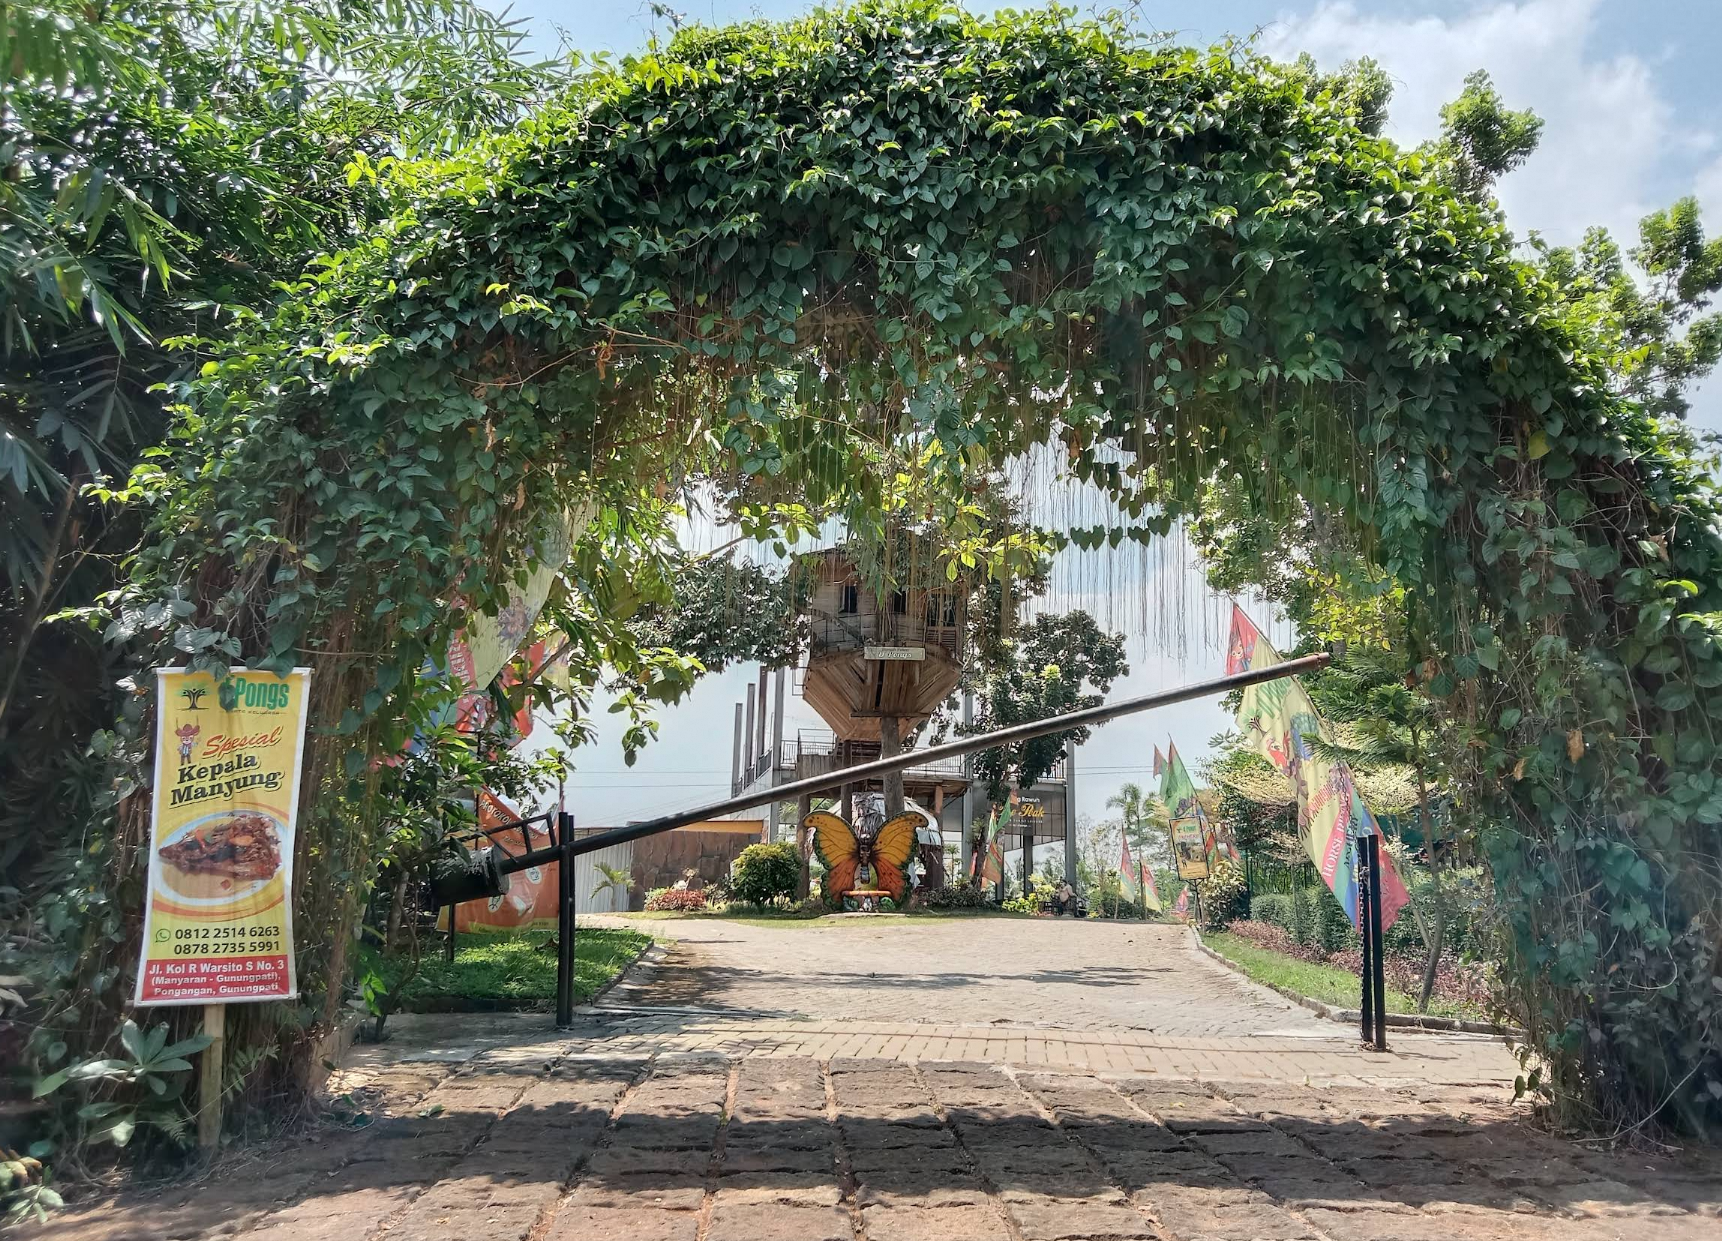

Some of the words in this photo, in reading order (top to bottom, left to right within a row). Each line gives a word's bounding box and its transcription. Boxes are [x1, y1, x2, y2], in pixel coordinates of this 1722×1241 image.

[202, 725, 282, 759] Spesial
[177, 753, 258, 785] Kepala
[170, 771, 281, 806] Manyung
[1320, 836, 1343, 878] HORSE
[175, 928, 210, 940] 0812
[213, 927, 246, 939] 2514
[249, 926, 280, 937] 6263
[174, 943, 209, 955] 0878
[212, 942, 245, 954] 2735
[249, 941, 280, 952] 5991
[166, 963, 185, 974] Kol
[189, 963, 198, 973] R
[201, 962, 243, 973] Warsito
[246, 961, 254, 971] S
[256, 960, 275, 971] No.
[277, 959, 285, 970] 3
[151, 976, 207, 986] (Manyaran
[154, 986, 217, 997] Pongangan,
[219, 982, 279, 993] Gunungpati
